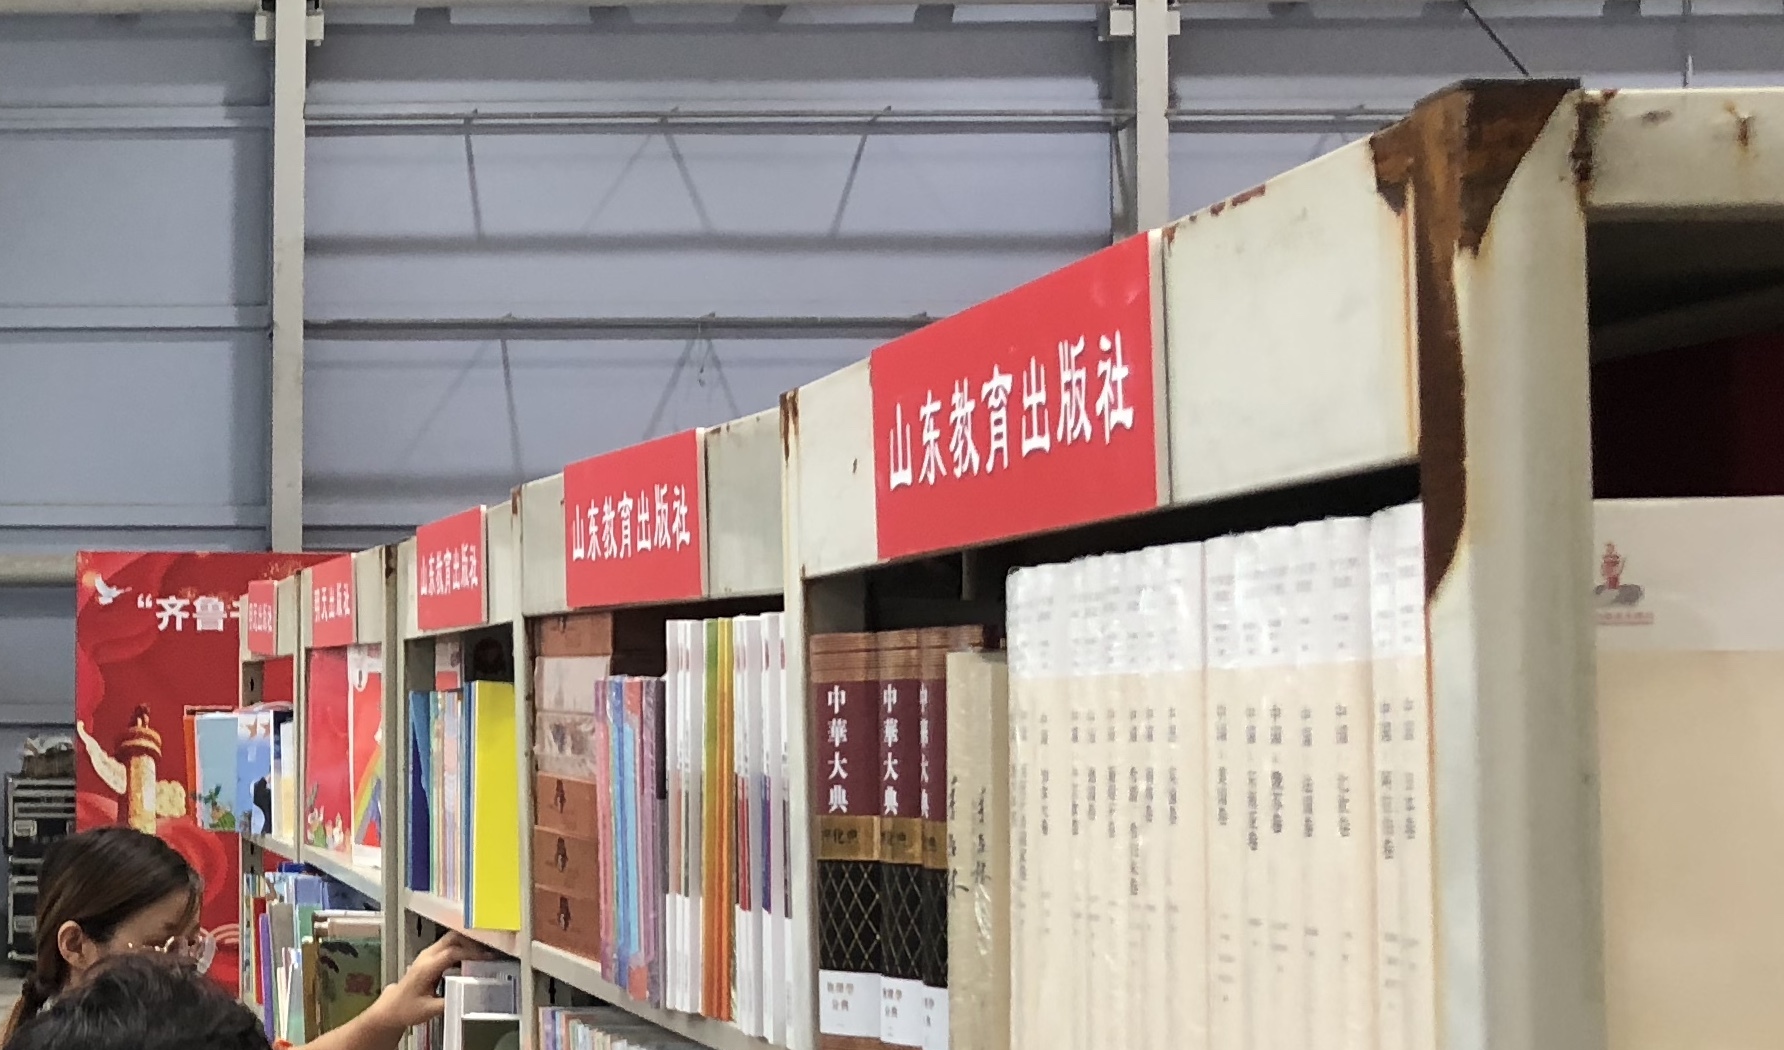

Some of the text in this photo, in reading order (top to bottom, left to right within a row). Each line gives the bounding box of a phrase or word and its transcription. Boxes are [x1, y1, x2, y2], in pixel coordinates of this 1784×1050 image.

[888, 330, 1134, 491] 山东教育出版社
[420, 543, 478, 596] 山东教育出版社
[571, 483, 691, 562] 山东教育出版社
[136, 594, 240, 633] “齐鲁
[827, 684, 848, 814] 中華大典
[883, 683, 899, 816] 中華大典
